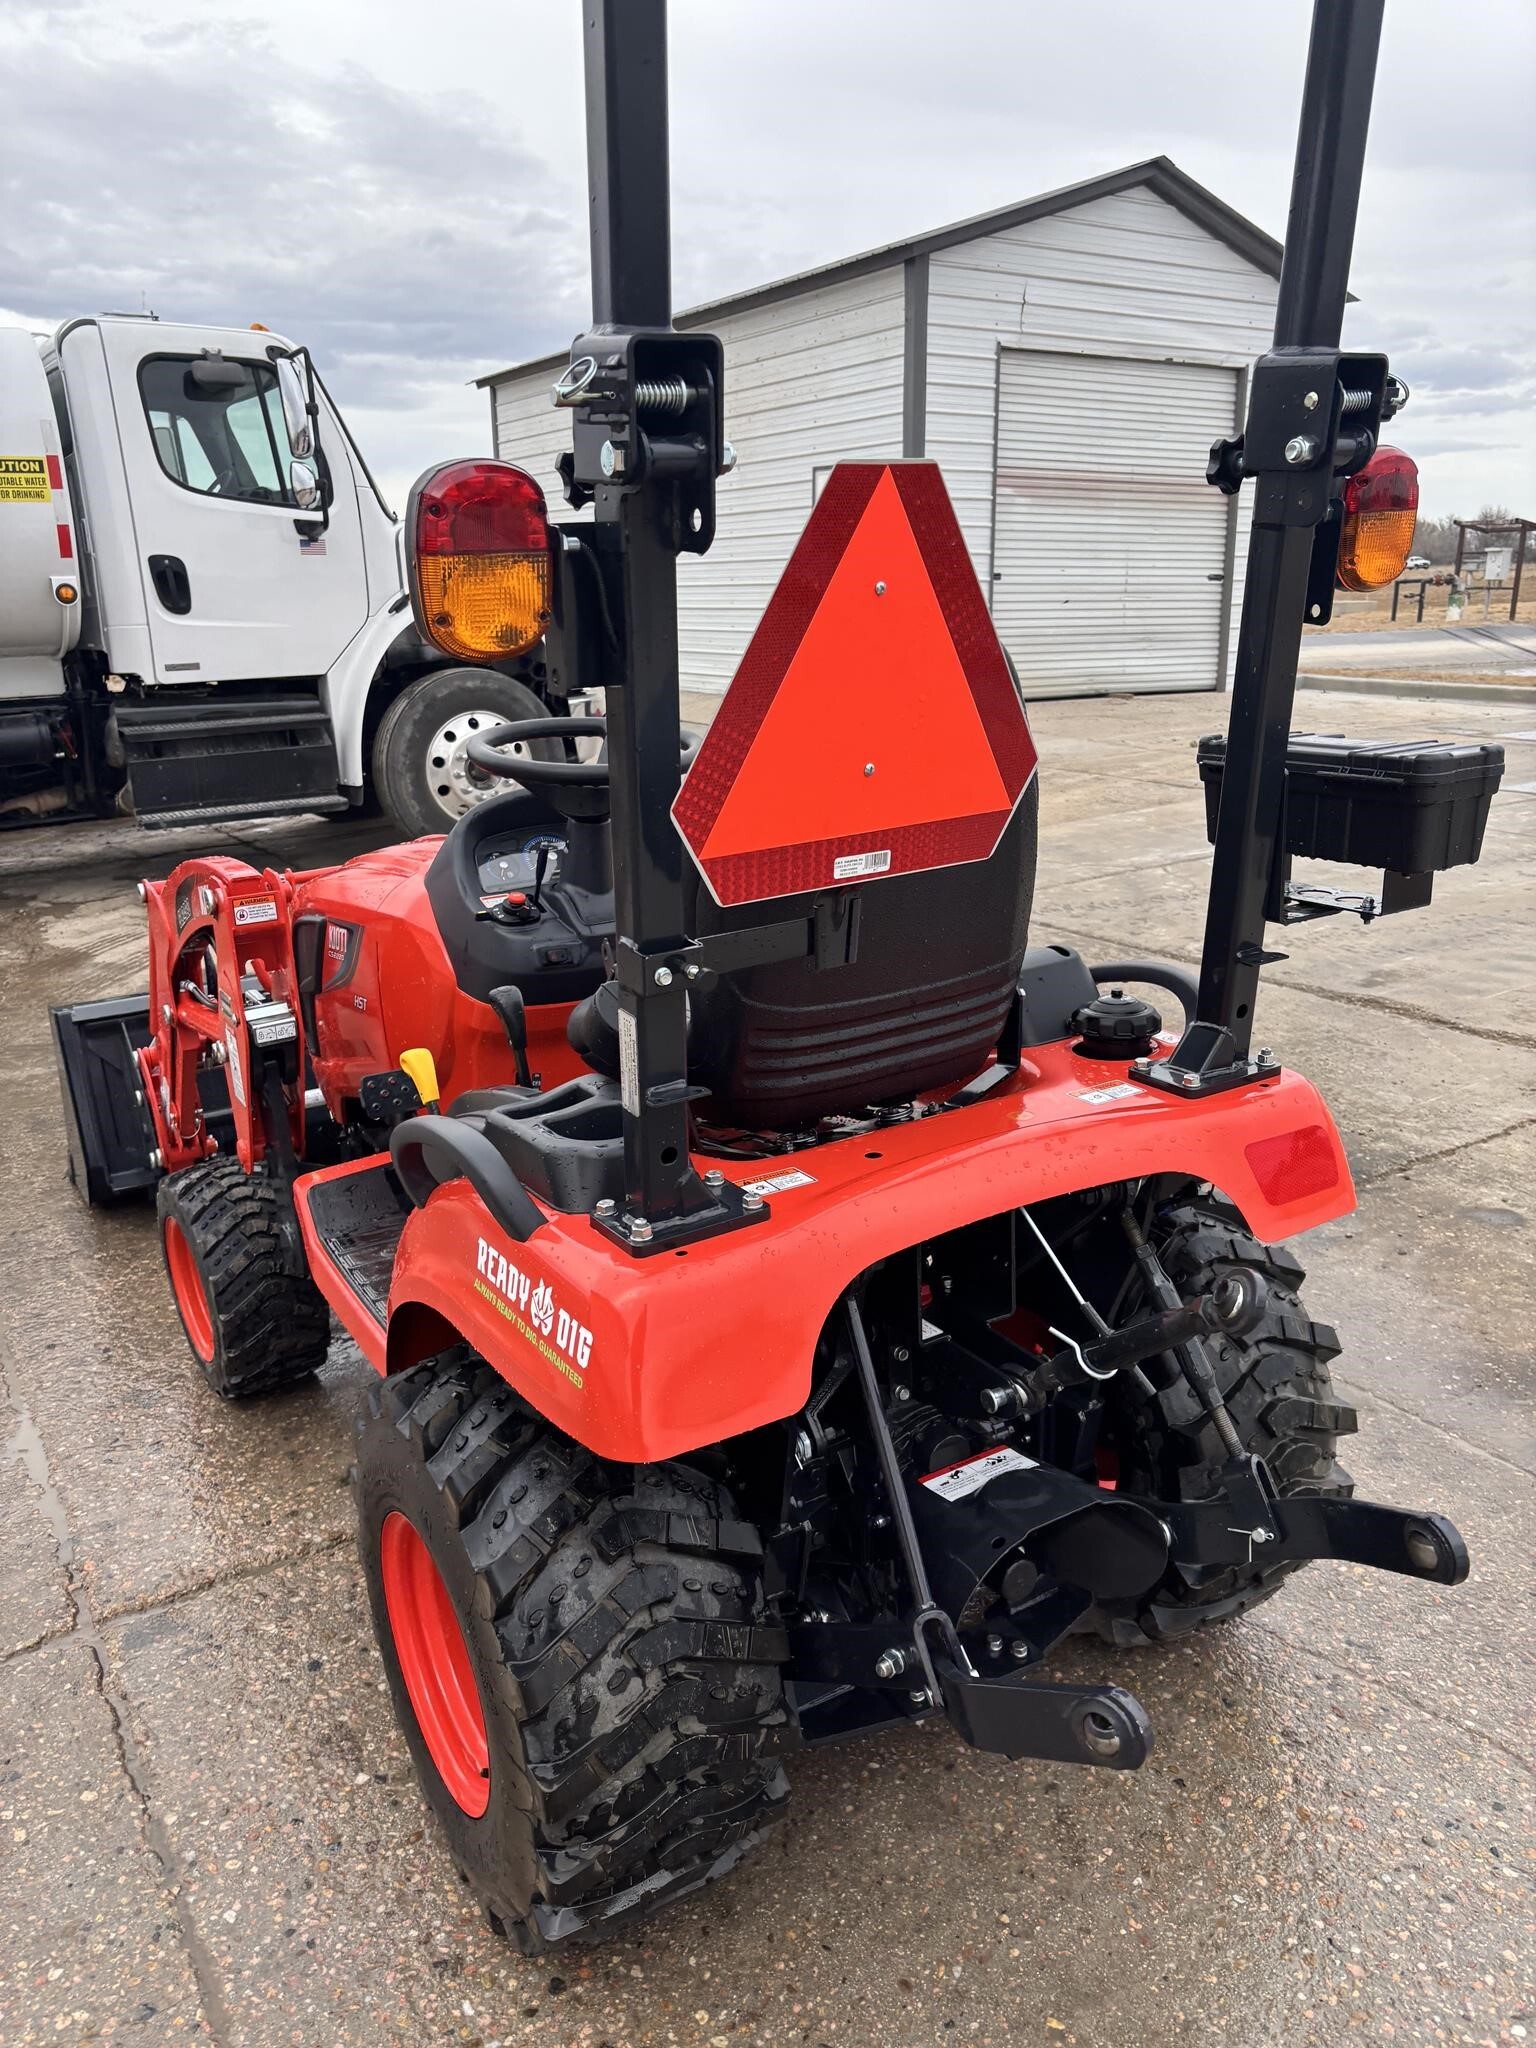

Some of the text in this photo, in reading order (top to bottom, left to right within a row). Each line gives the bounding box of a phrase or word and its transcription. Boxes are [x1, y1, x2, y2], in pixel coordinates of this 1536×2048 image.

[24, 477, 47, 486] WATER
[12, 490, 45, 499] DRINKING
[354, 995, 367, 1011] HST
[477, 1236, 531, 1311] READY
[474, 1278, 583, 1389] ALWAYS READY TO DIG. GUARANTEED
